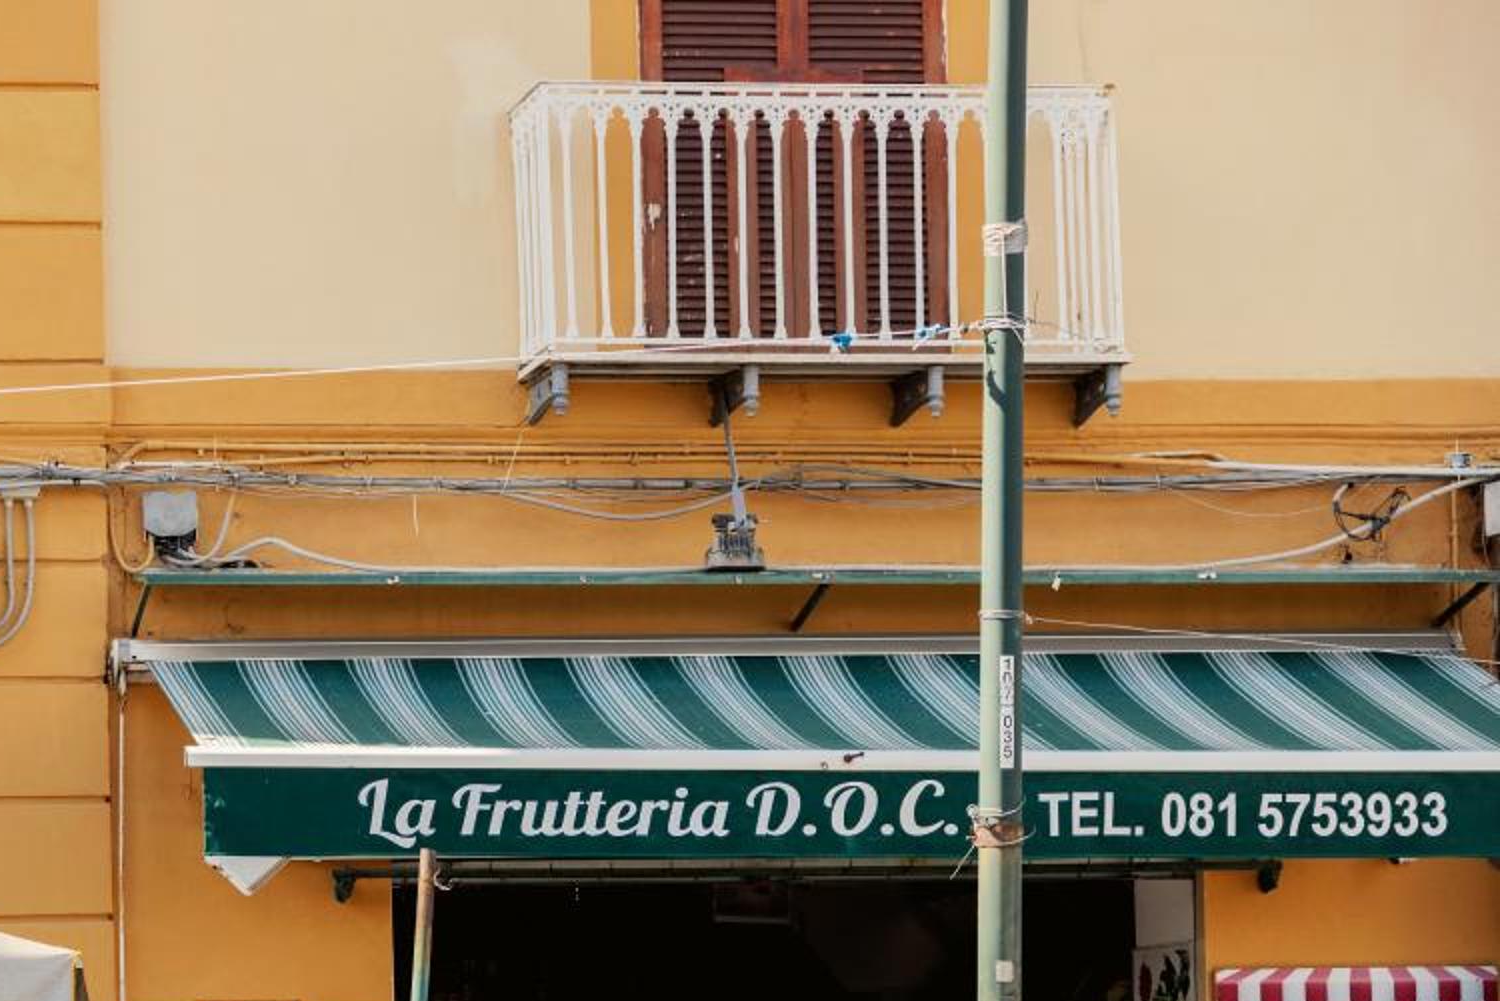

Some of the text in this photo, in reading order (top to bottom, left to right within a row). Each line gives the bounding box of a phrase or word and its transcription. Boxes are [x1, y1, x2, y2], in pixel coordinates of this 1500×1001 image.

[357, 778, 959, 849] La Frutteria D.O.C.
[1038, 791, 1448, 838] TEL. 081 5753933
